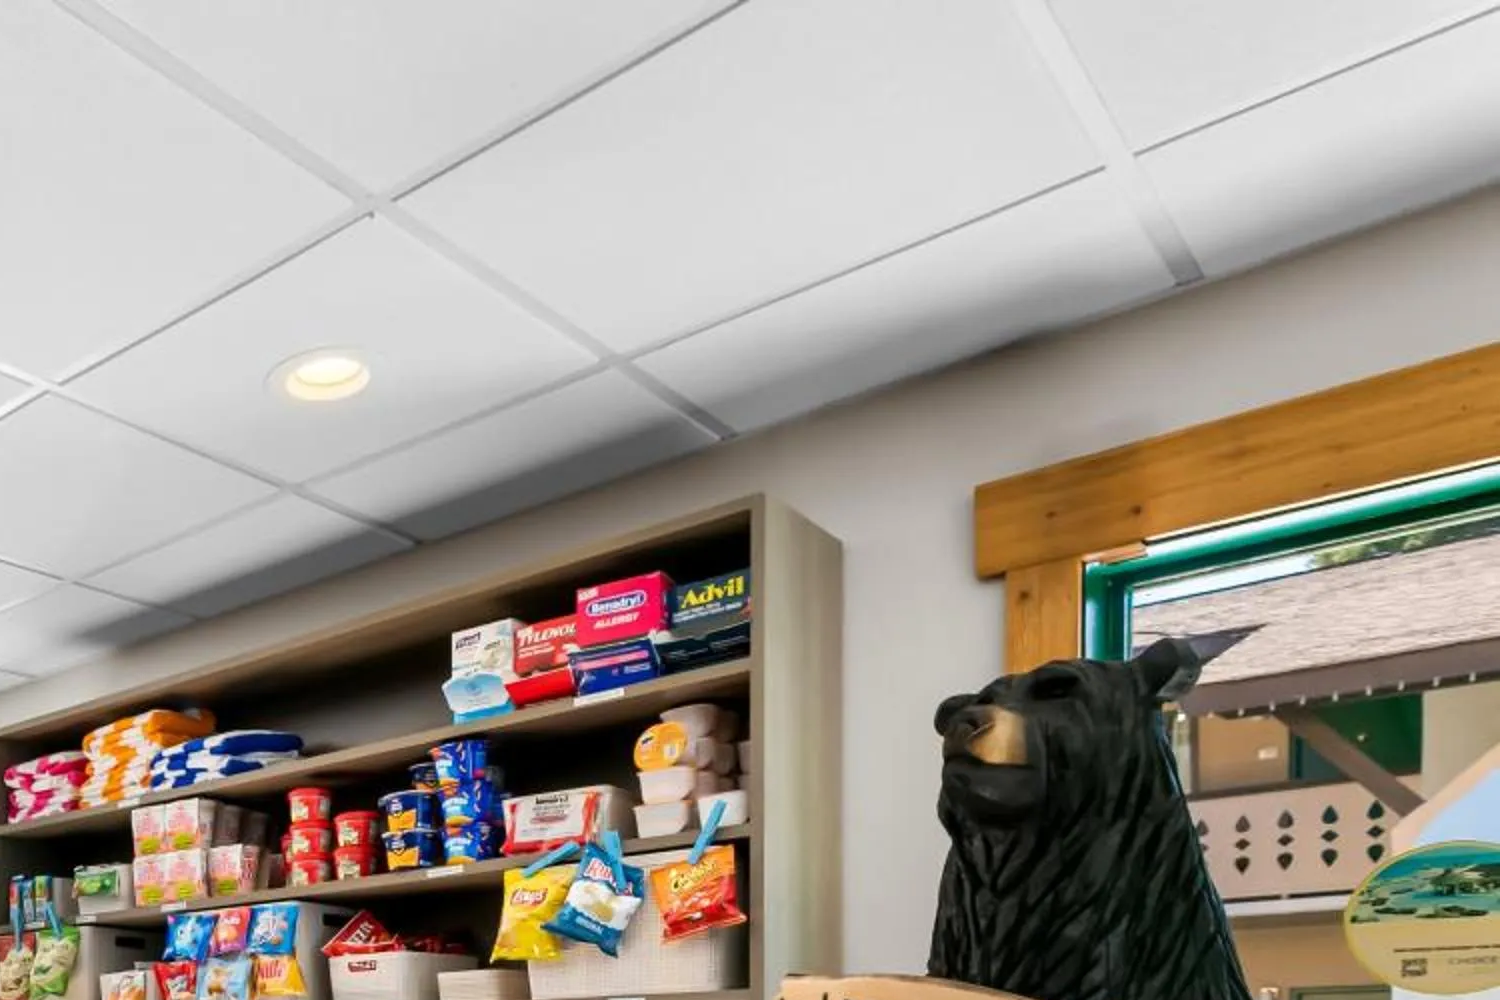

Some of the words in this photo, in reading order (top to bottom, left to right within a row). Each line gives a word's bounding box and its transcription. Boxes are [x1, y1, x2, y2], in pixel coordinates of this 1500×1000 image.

[681, 575, 745, 609] Advil
[591, 593, 642, 614] Benadryl
[594, 612, 640, 629] ALLERGY
